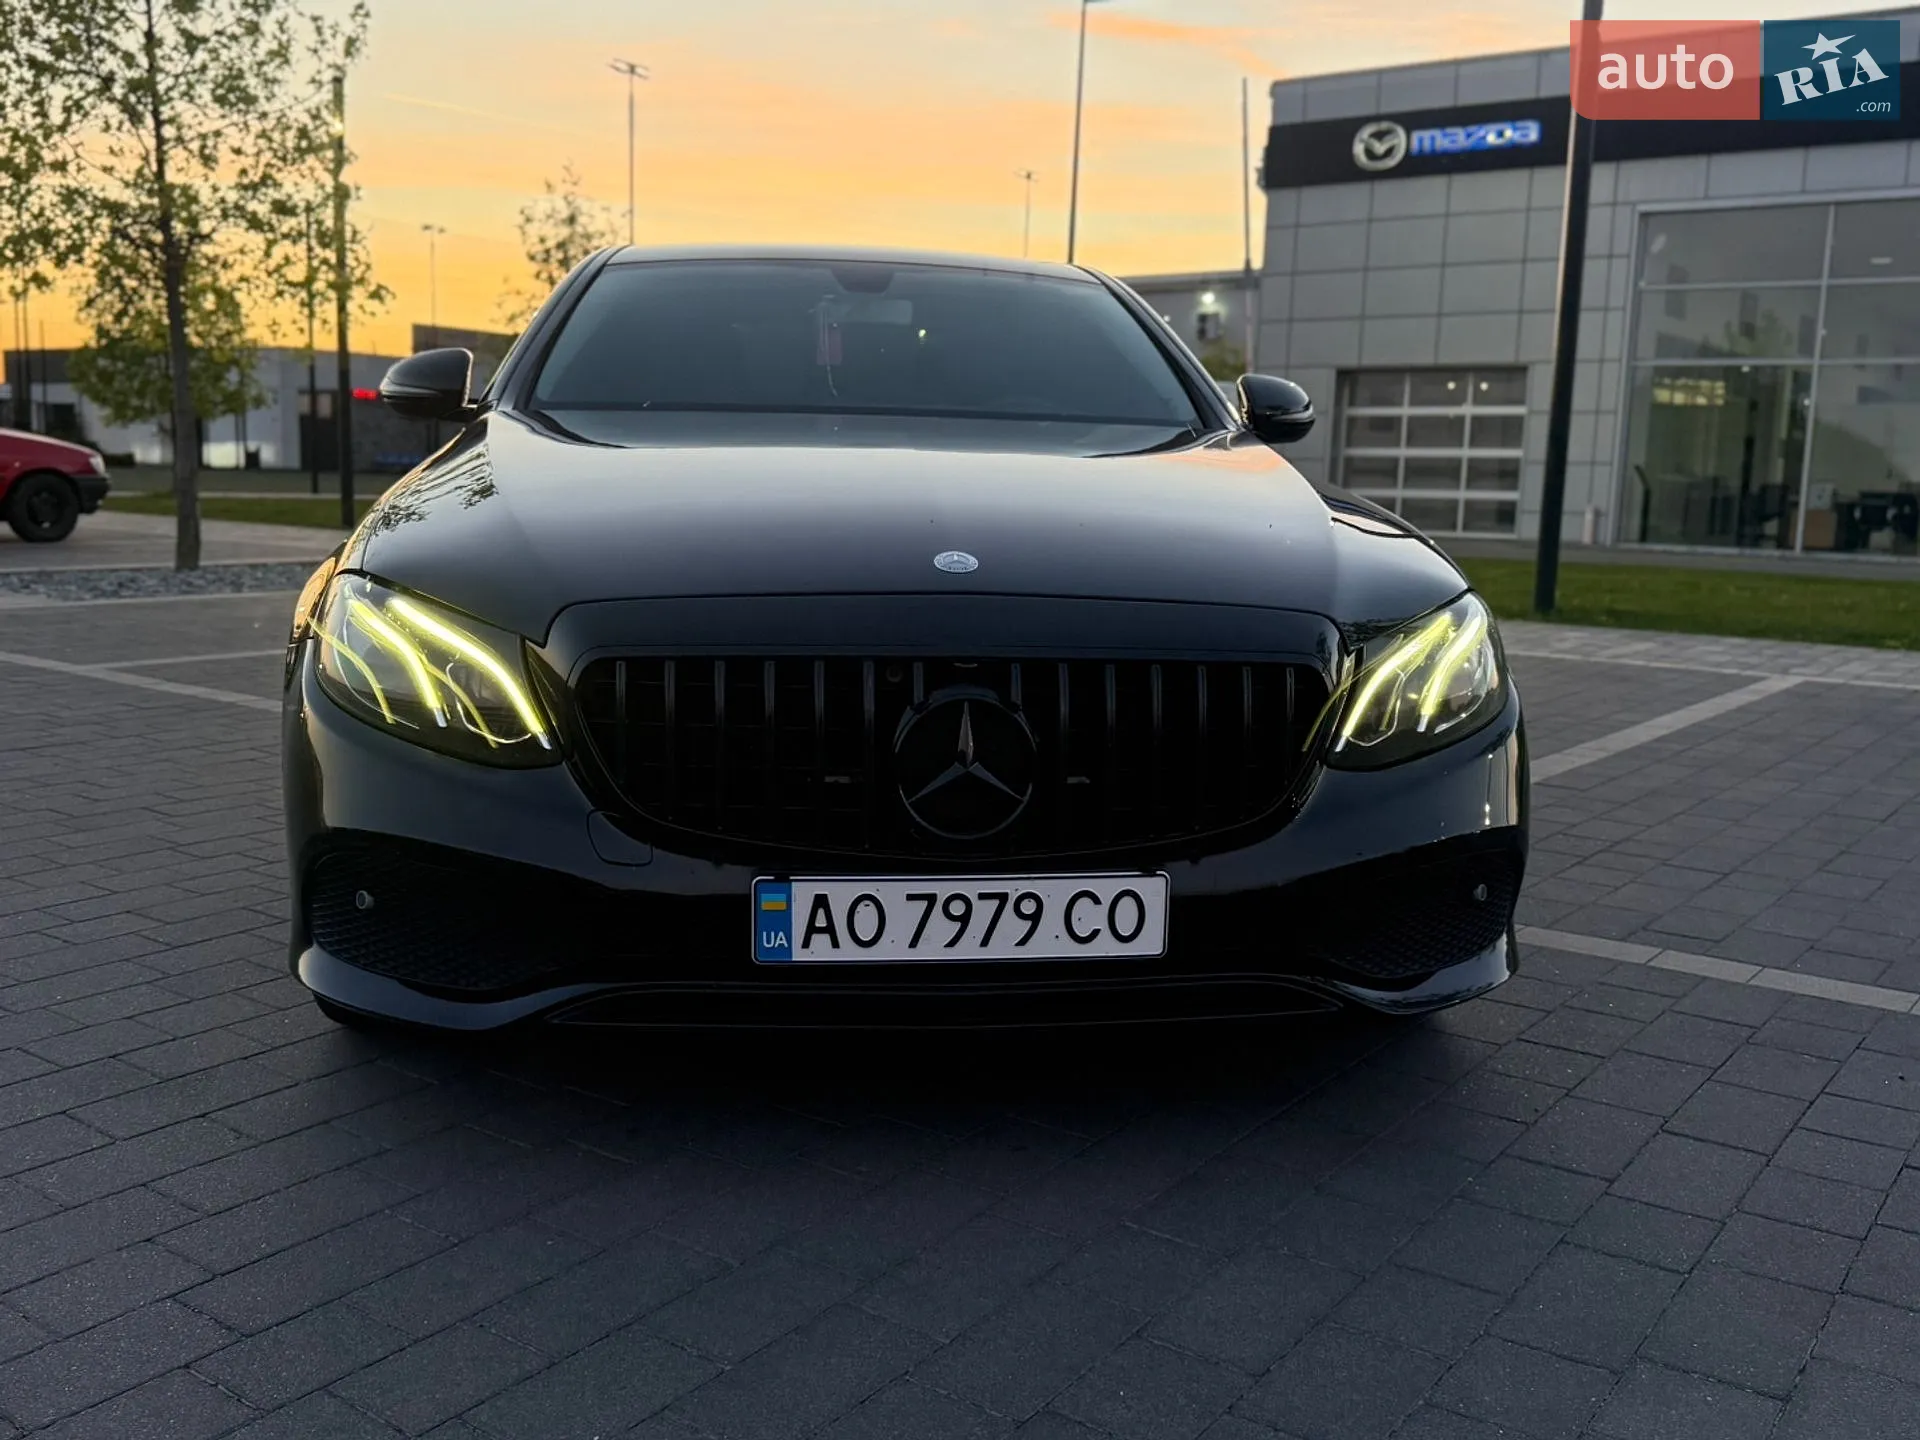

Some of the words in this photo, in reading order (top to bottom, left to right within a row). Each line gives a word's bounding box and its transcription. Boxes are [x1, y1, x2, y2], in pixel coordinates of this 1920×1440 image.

[800, 892, 888, 949] AO
[904, 891, 1045, 949] 7979
[1063, 888, 1147, 946] CO
[762, 930, 789, 948] UA
